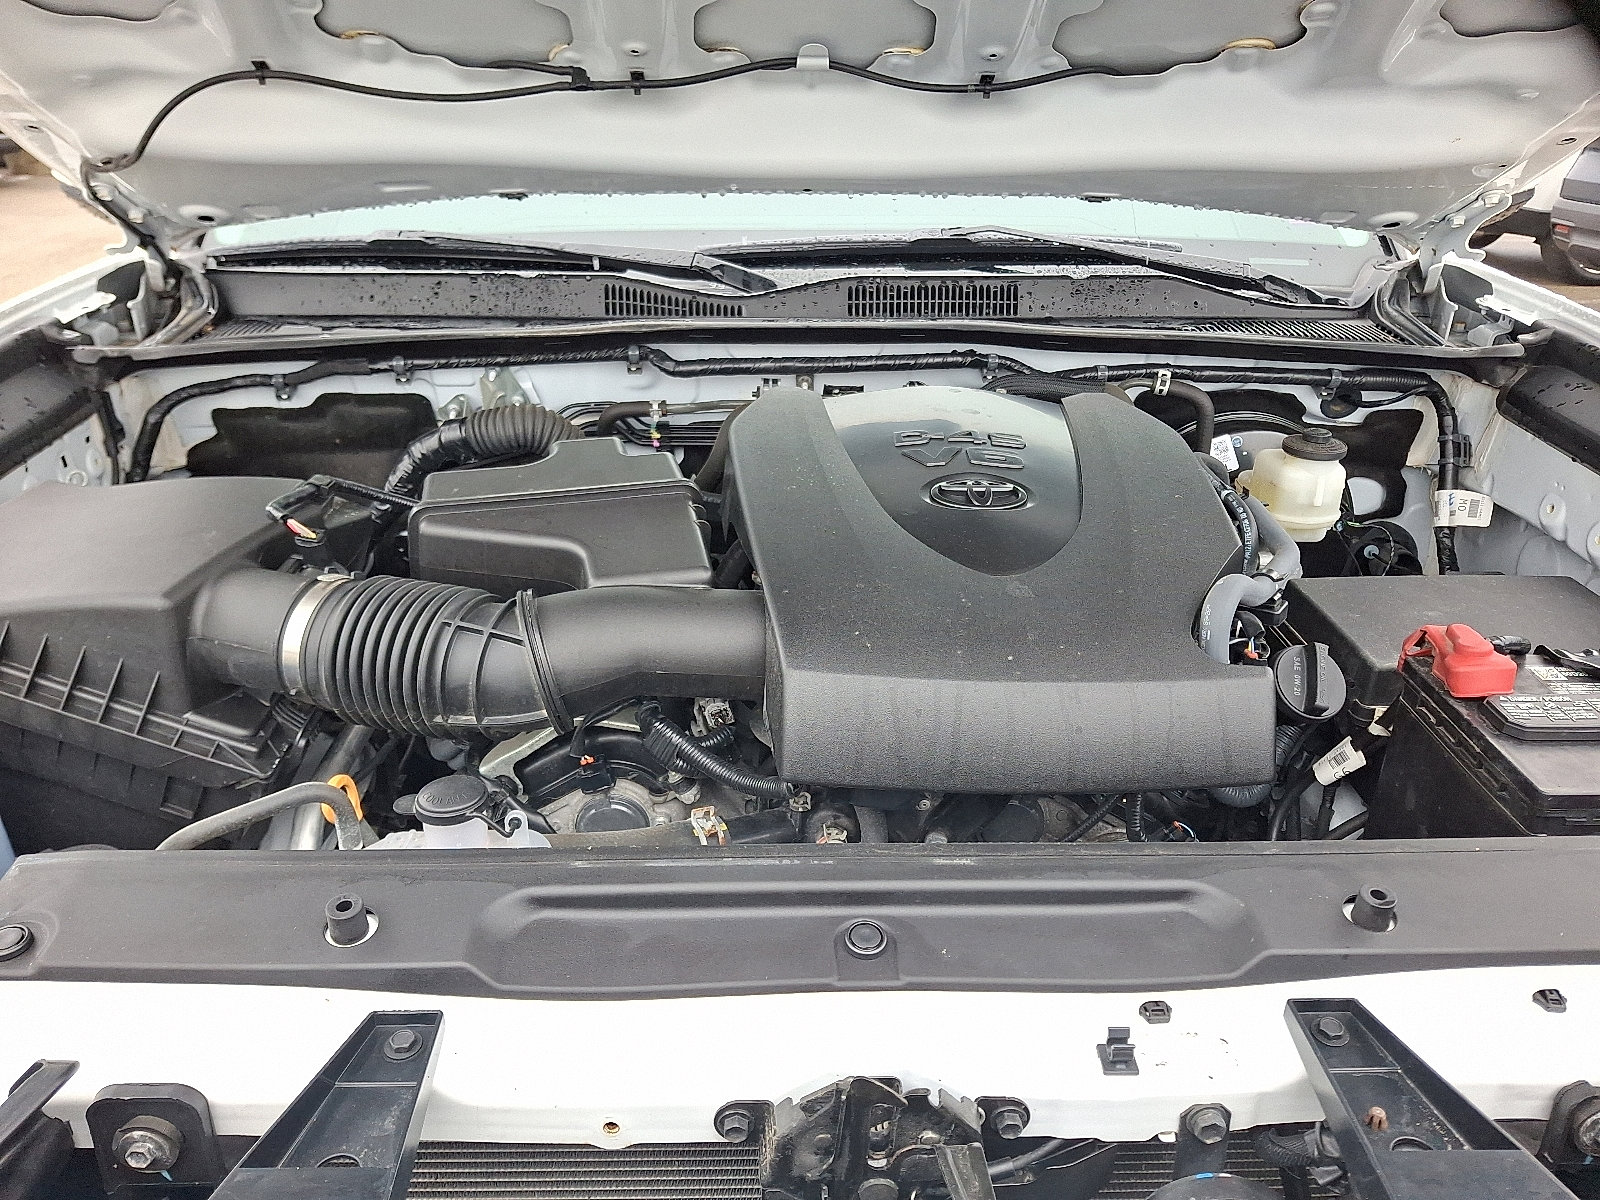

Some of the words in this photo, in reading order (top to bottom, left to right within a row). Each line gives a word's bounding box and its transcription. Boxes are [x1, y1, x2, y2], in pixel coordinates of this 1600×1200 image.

[893, 429, 1027, 449] D-4S
[901, 447, 1025, 469] V6
[1293, 656, 1302, 671] SAE
